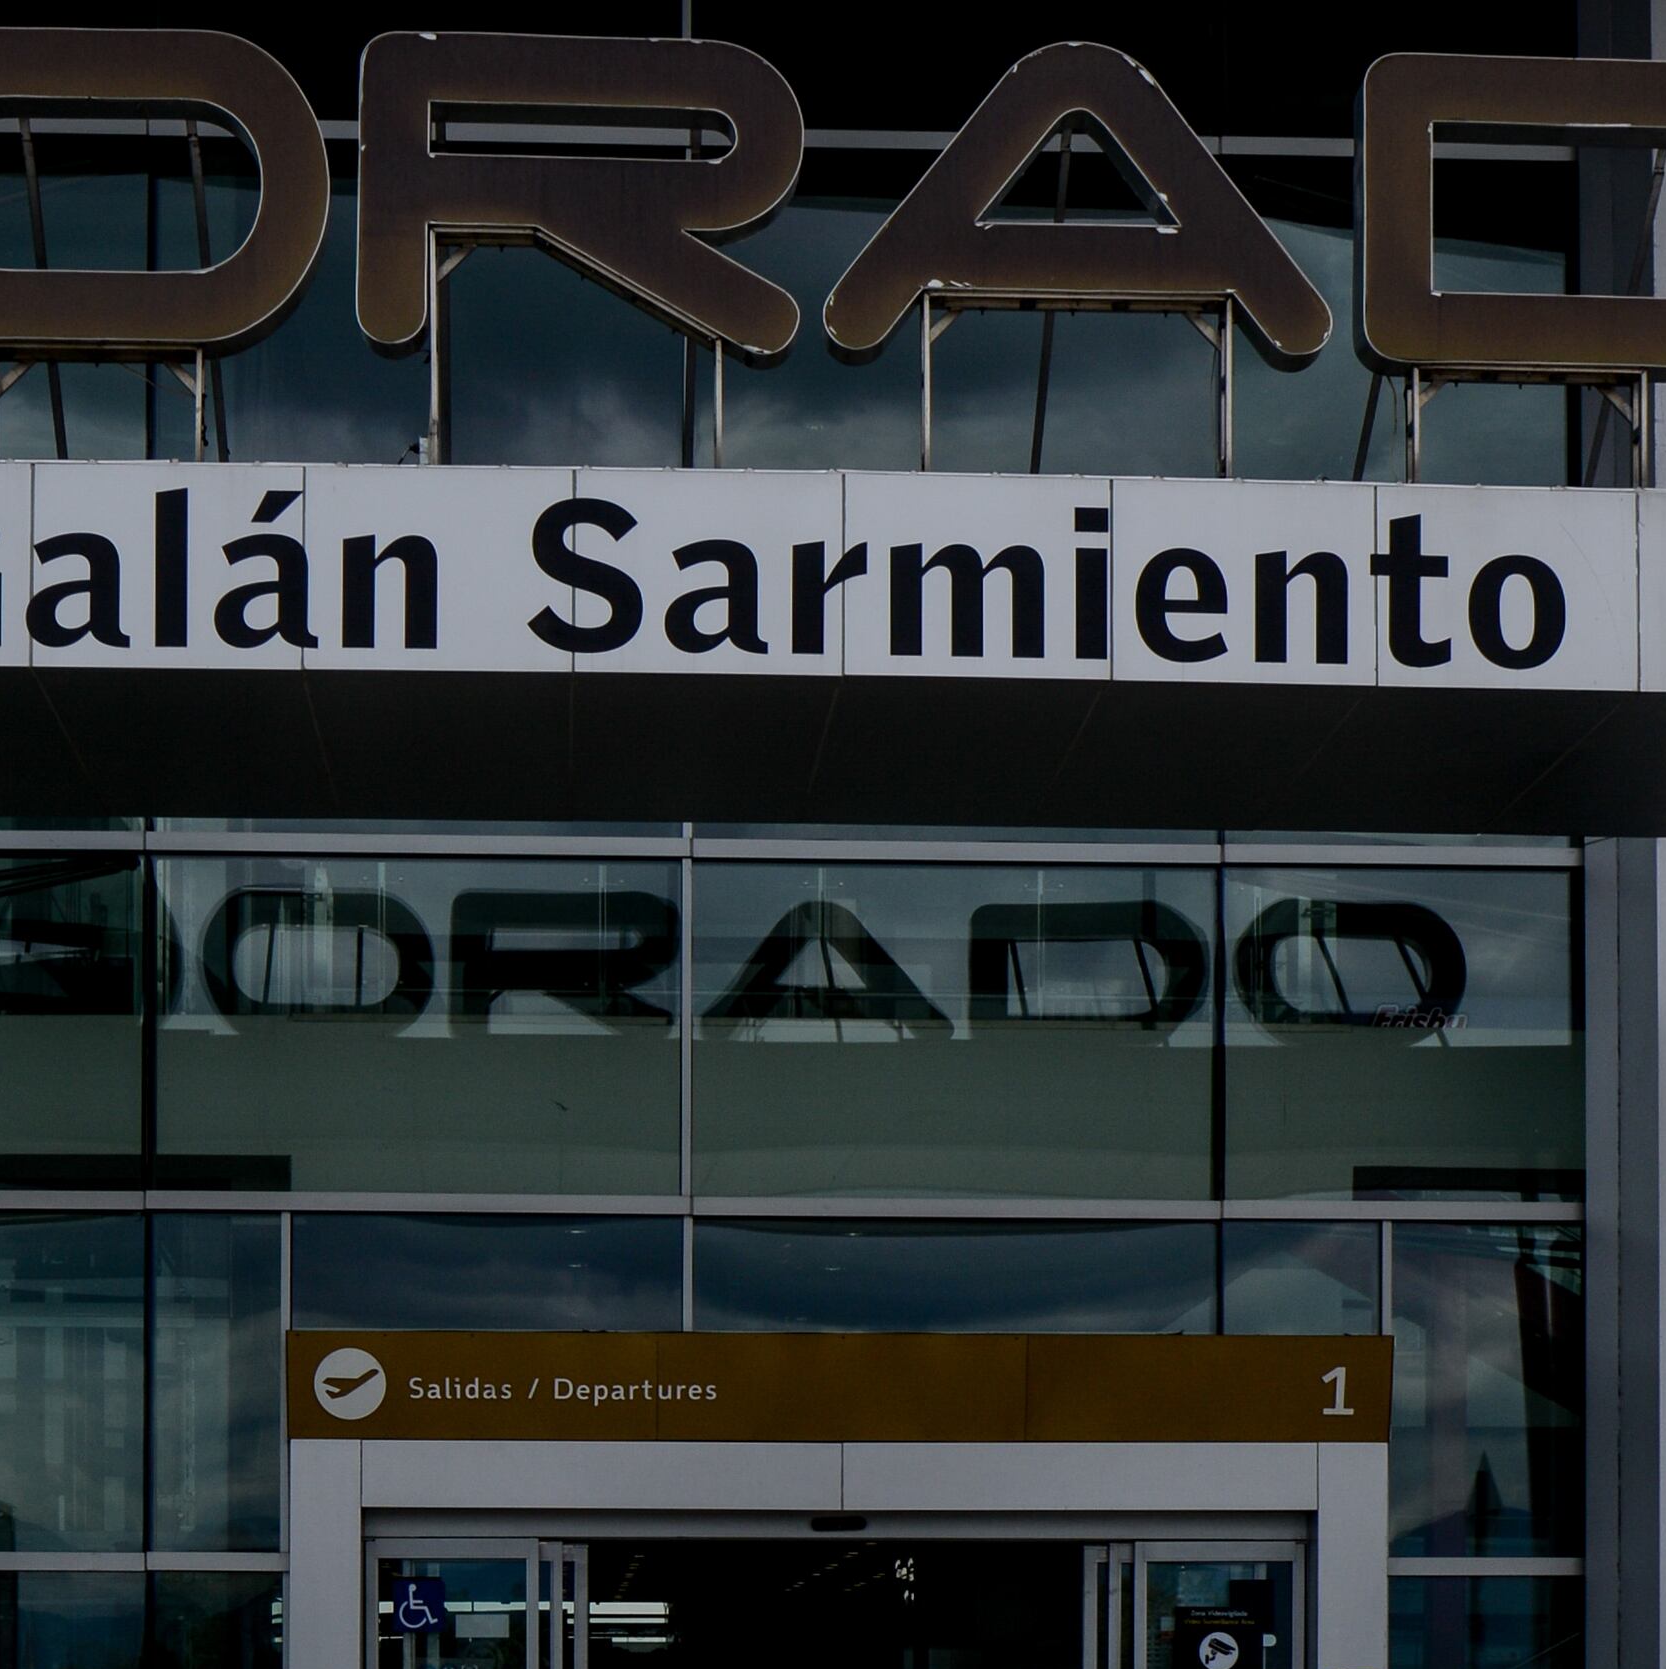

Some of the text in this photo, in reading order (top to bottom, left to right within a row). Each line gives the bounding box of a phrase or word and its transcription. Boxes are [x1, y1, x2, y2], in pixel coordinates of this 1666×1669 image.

[529, 498, 1567, 669] Sarmiento
[409, 1375, 718, 1405] Salidas / Departures
[1320, 1367, 1354, 1416] 1
